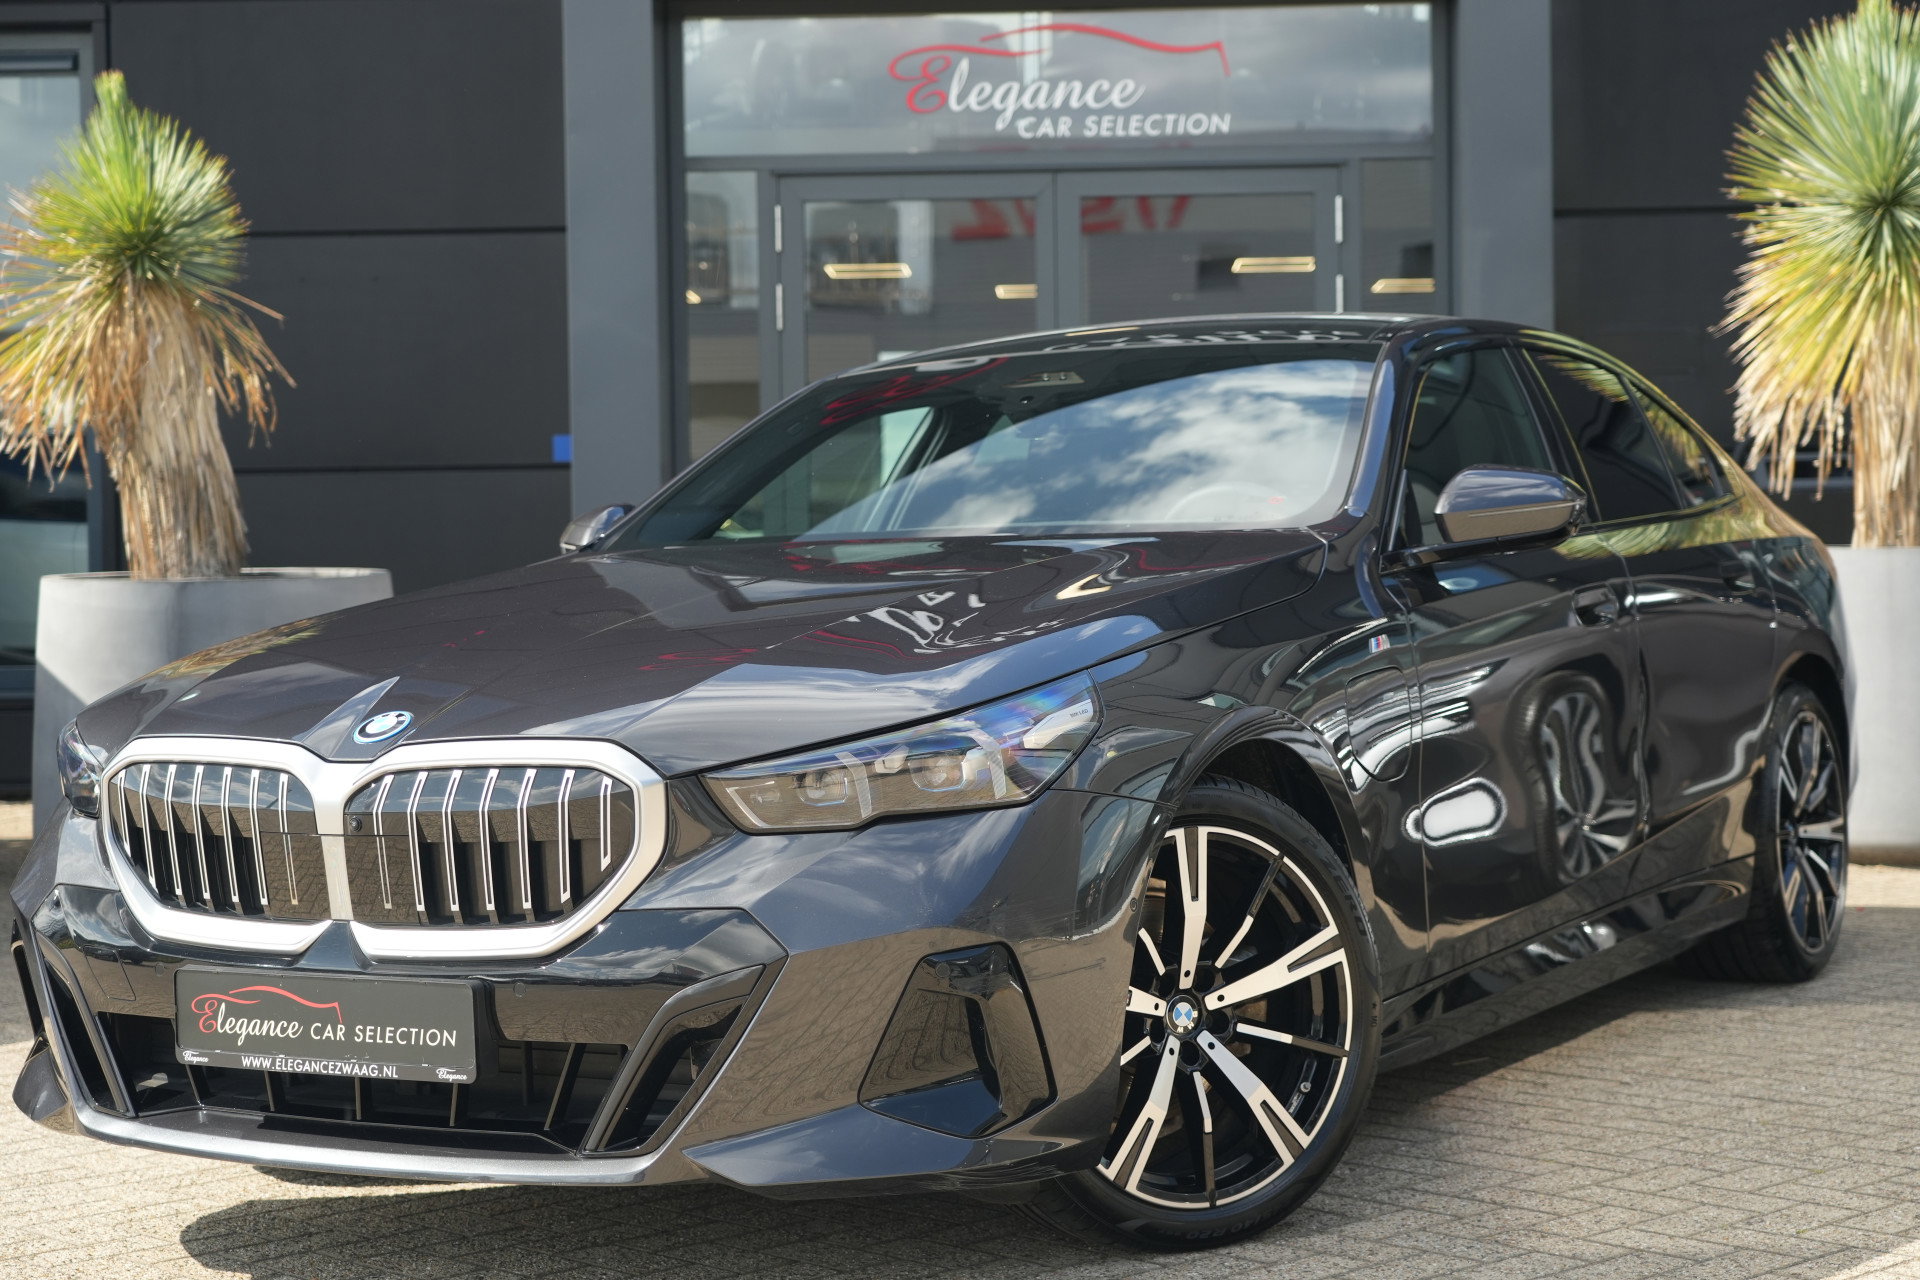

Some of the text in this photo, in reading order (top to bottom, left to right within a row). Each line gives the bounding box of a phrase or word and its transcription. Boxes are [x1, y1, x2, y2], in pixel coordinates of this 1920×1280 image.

[888, 45, 1145, 131] Elegance
[1017, 113, 1231, 138] CAR SELECTION
[191, 993, 457, 1047] Elegance CAR SELECTION
[182, 1050, 209, 1064] Elegance
[241, 1055, 399, 1078] WWW.ELEGANCEZWAAG.NL
[436, 1067, 468, 1082] Elegance
